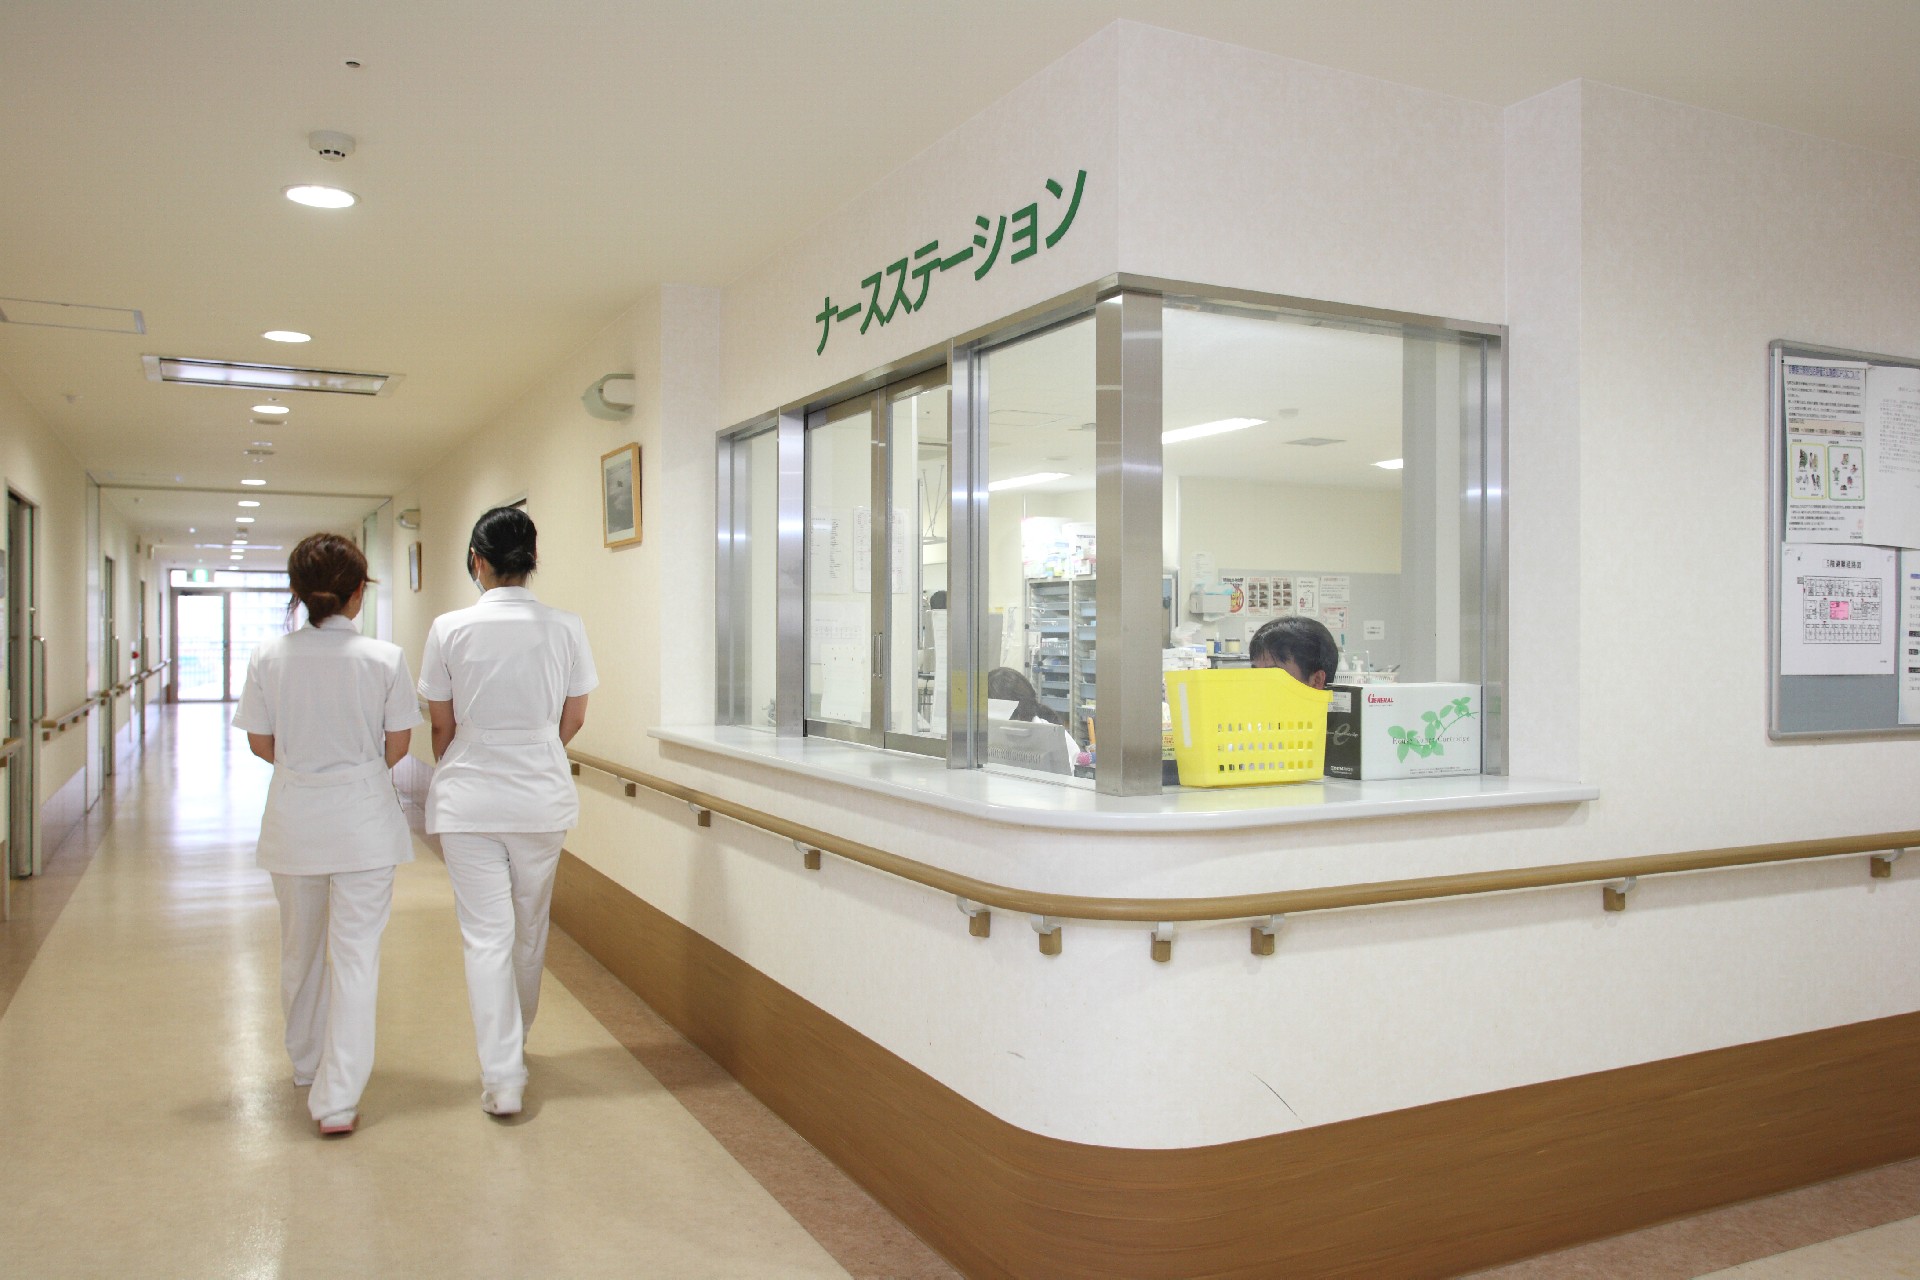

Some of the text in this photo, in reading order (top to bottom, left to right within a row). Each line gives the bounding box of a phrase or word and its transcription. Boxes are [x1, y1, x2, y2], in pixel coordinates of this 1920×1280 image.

[815, 169, 1087, 356] ナースステーション
